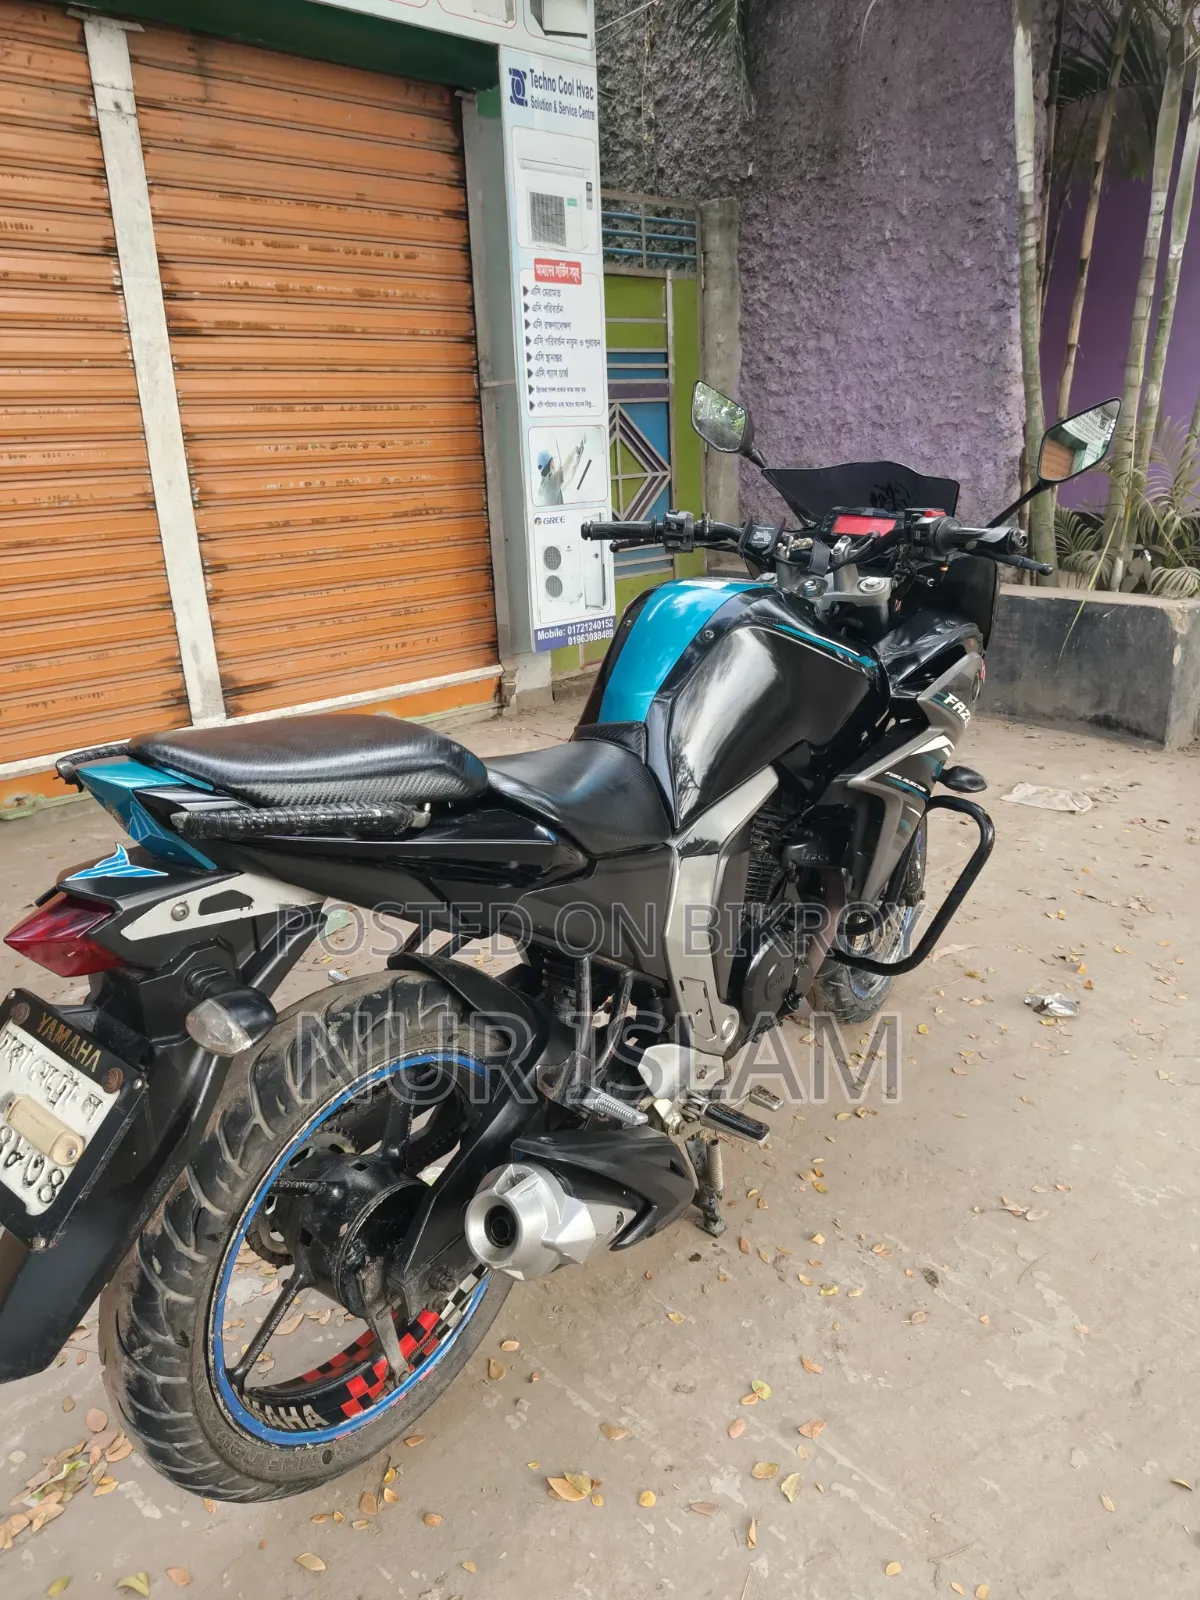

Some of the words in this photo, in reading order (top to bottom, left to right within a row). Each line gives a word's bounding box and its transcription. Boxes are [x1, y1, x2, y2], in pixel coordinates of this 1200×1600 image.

[529, 68, 556, 92] Techno
[558, 75, 574, 96] Cool
[576, 79, 593, 100] Hvac
[530, 95, 552, 113] Solution
[553, 100, 558, 113] &
[558, 101, 577, 117] Service
[578, 105, 595, 120] Centre
[531, 284, 541, 296] এসি
[532, 301, 542, 313] এসি
[533, 317, 543, 330] এসি
[534, 334, 544, 346] এসি
[534, 350, 544, 362] এসি
[535, 366, 545, 378] এসি
[543, 516, 565, 525] GREE
[537, 627, 566, 641] Mobile:
[567, 618, 614, 635] 01721240152
[567, 629, 614, 646] 01963088489
[37, 1012, 102, 1073] YAMAHA
